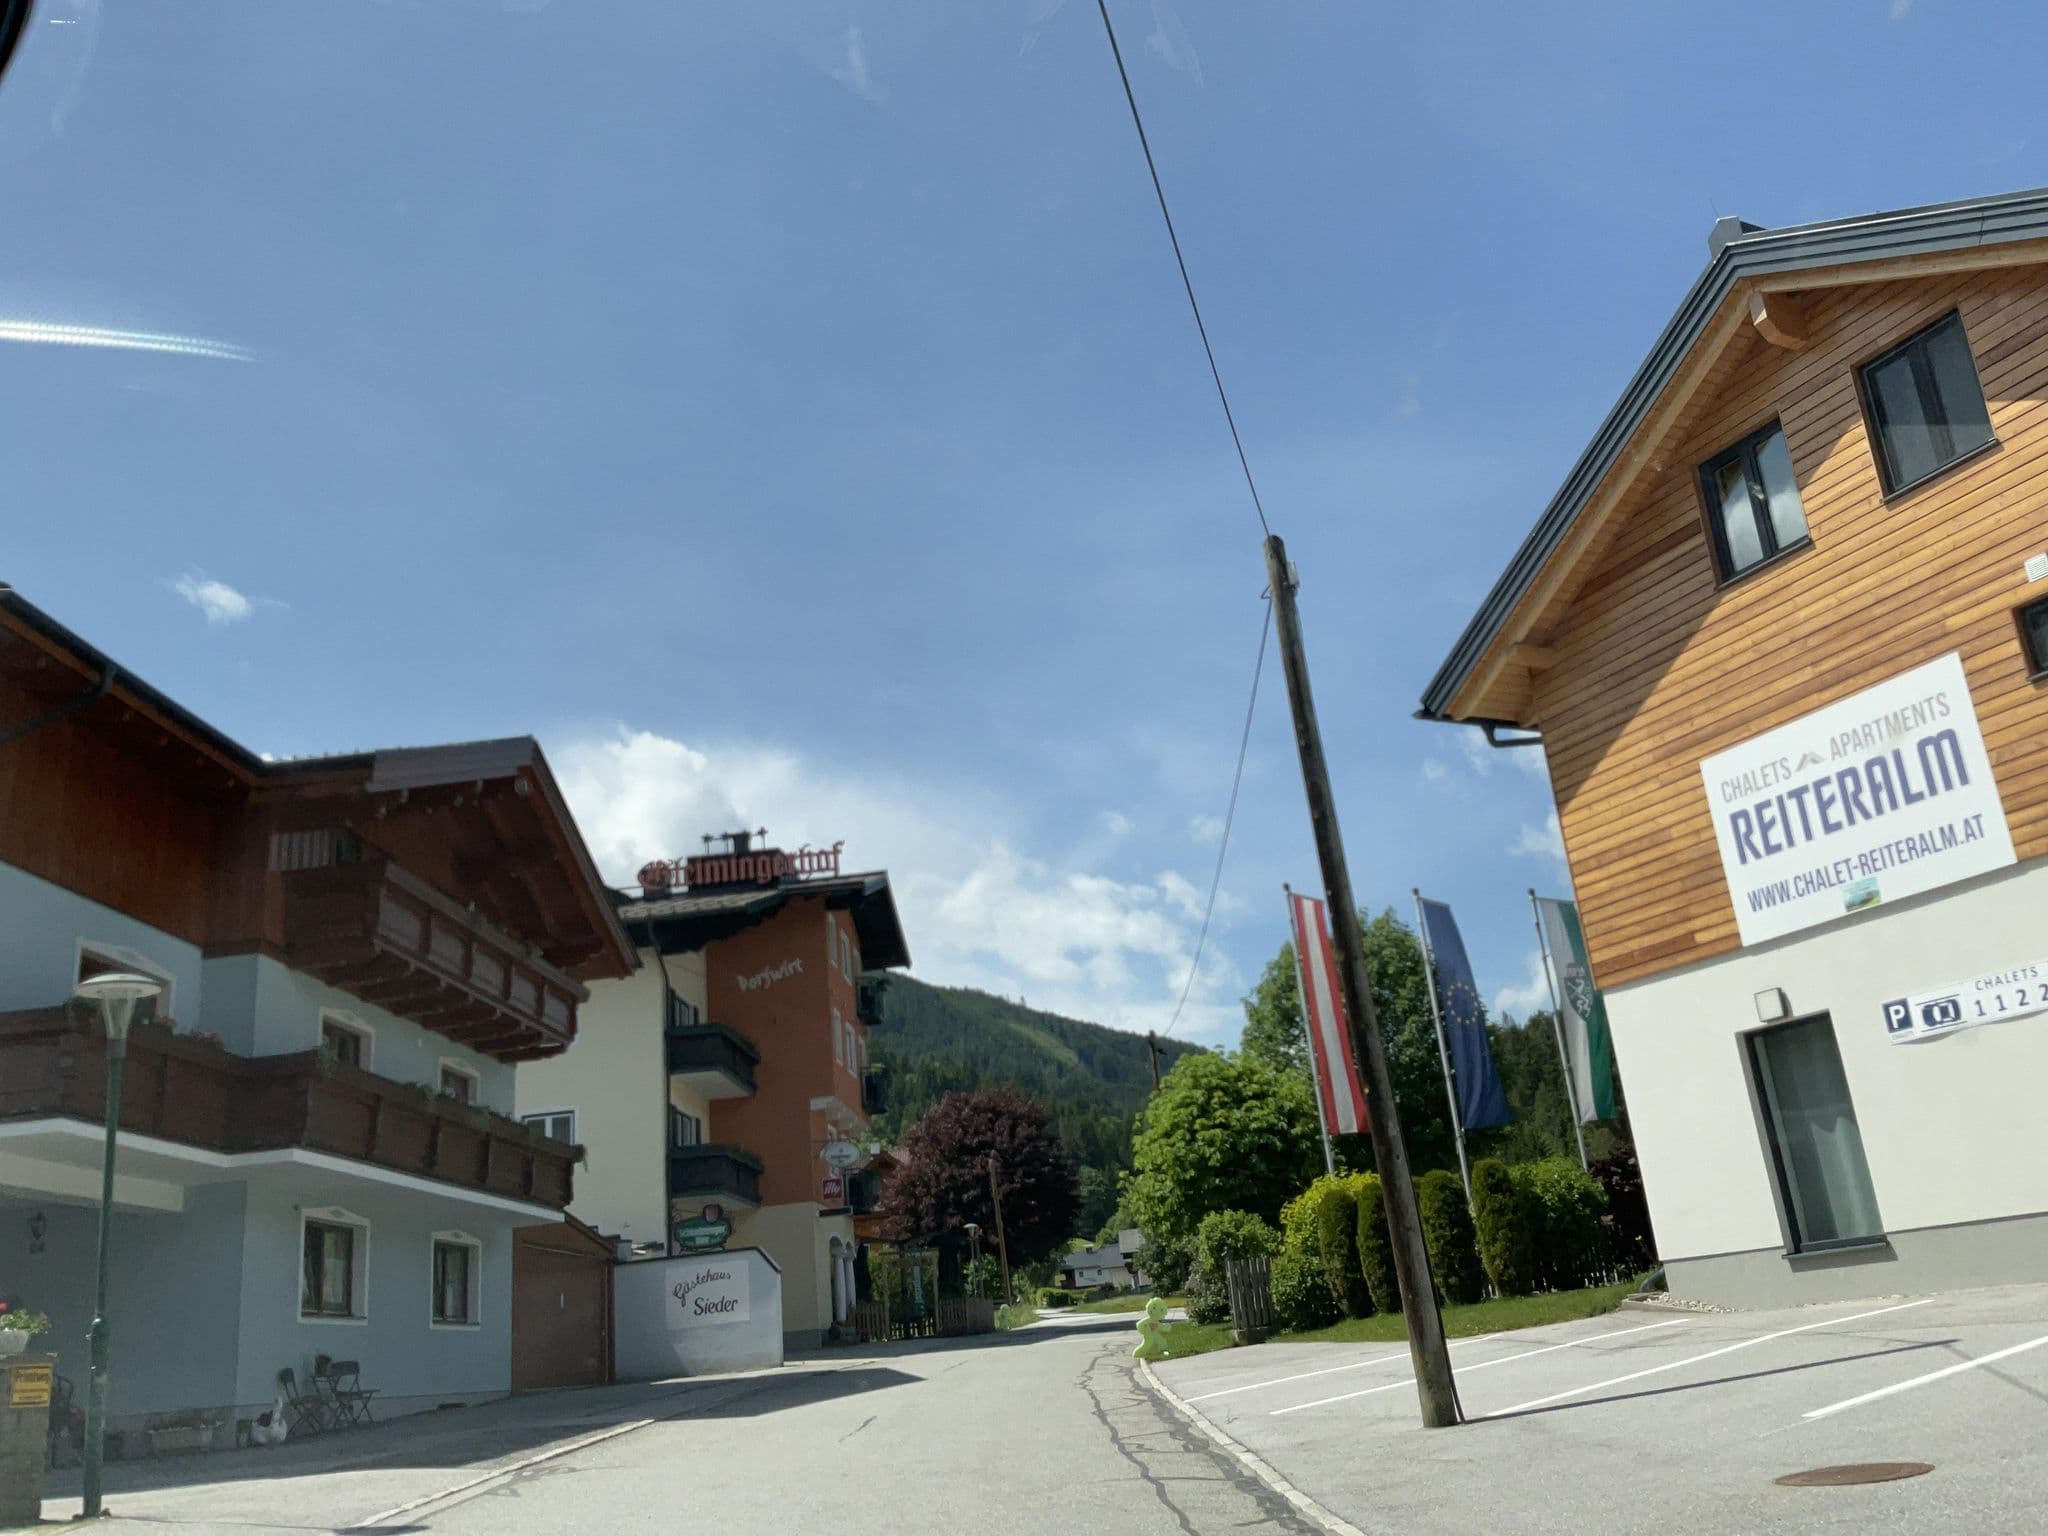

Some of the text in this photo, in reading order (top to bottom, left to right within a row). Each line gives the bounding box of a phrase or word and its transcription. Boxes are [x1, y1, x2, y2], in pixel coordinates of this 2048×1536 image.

[1721, 692, 1951, 803] CHALETS APARTMENTS
[1730, 728, 1970, 865] REITERALM
[1748, 814, 1985, 912] WWW.CHALET-REITERALM.AT
[1976, 966, 2038, 991] CHALETS
[672, 1269, 731, 1307] Gästehaus
[694, 1296, 738, 1316] Sieder
